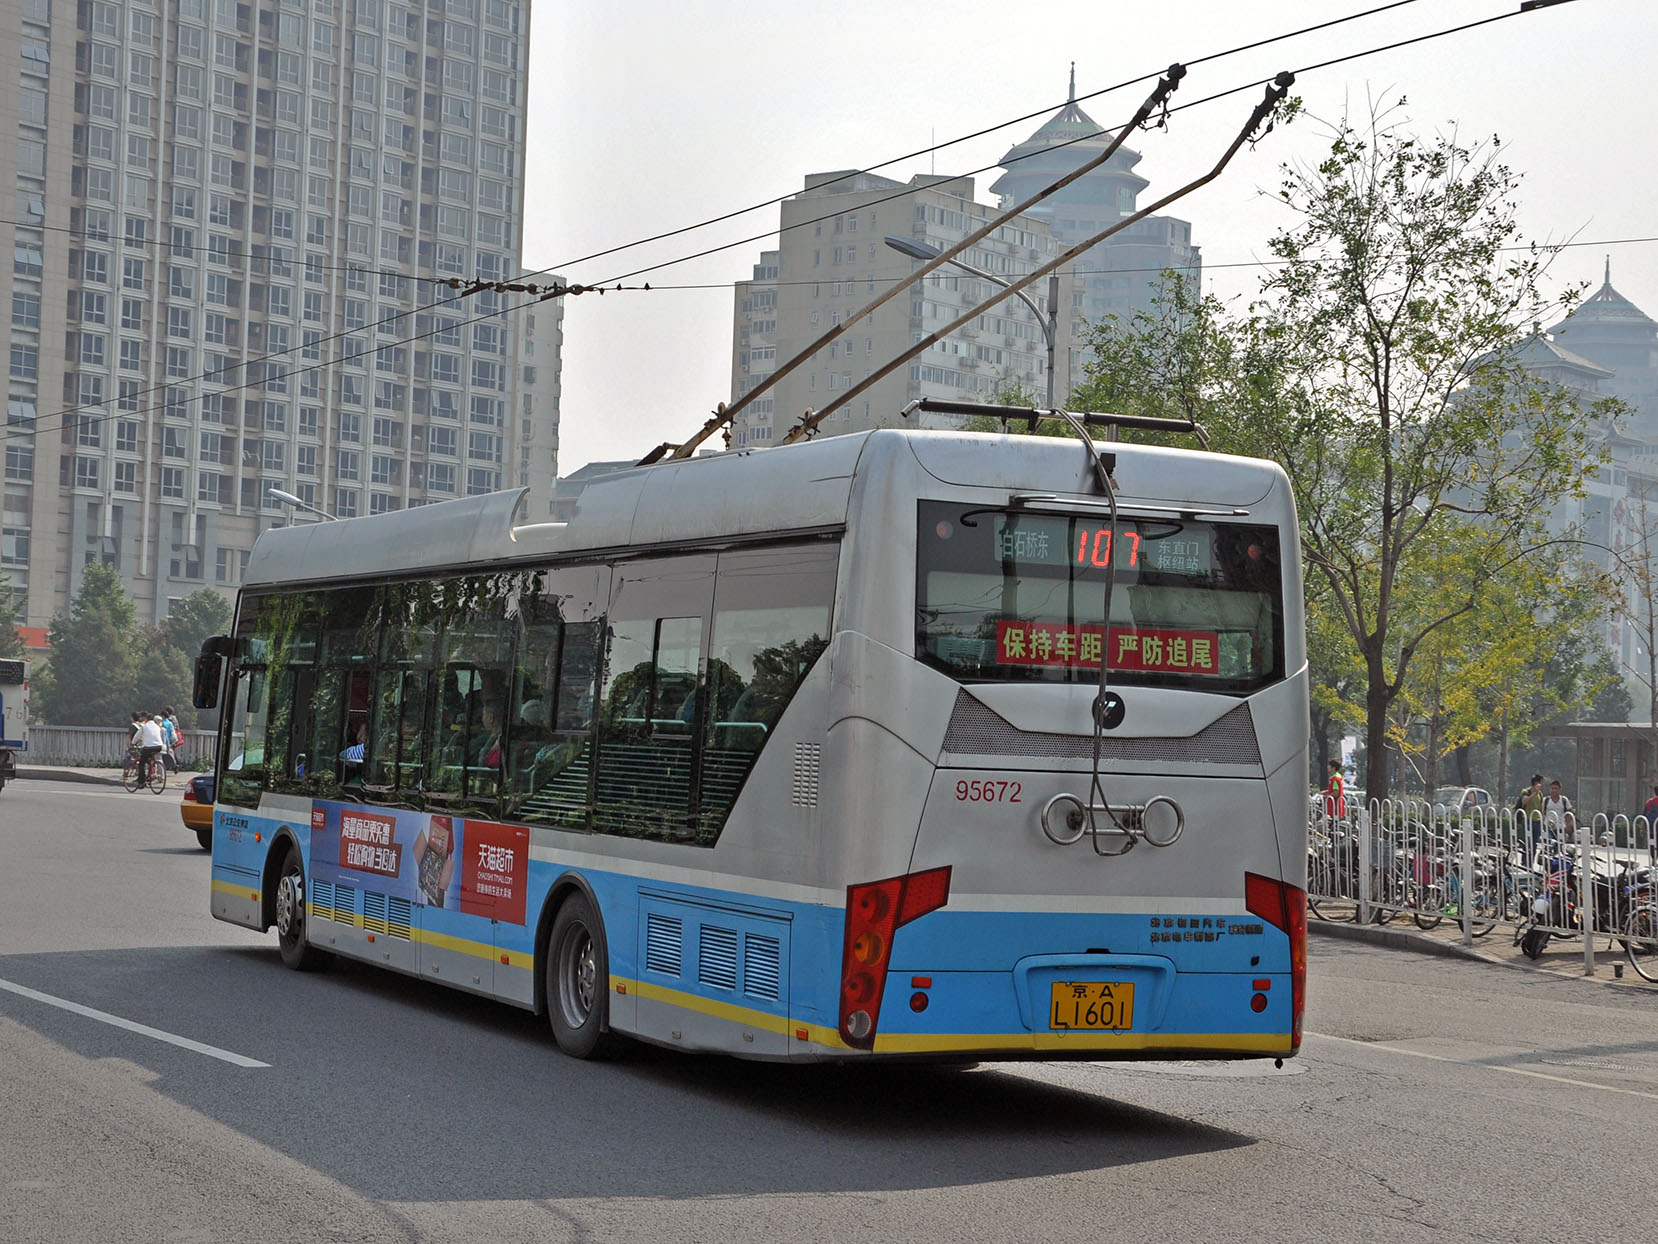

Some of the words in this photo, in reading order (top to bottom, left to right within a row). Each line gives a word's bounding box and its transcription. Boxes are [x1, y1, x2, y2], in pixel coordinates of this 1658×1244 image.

[1002, 530, 1049, 559] 白石桥东
[1077, 530, 1140, 567] 107
[1159, 540, 1199, 556] 东直门
[1157, 555, 1200, 570] 枢纽站
[1003, 627, 1102, 661] 保持车距
[1117, 634, 1213, 668] 严防追尾
[955, 780, 1022, 803] 95672
[478, 843, 514, 873] 天猫超市
[1055, 1001, 1124, 1026] L1601
